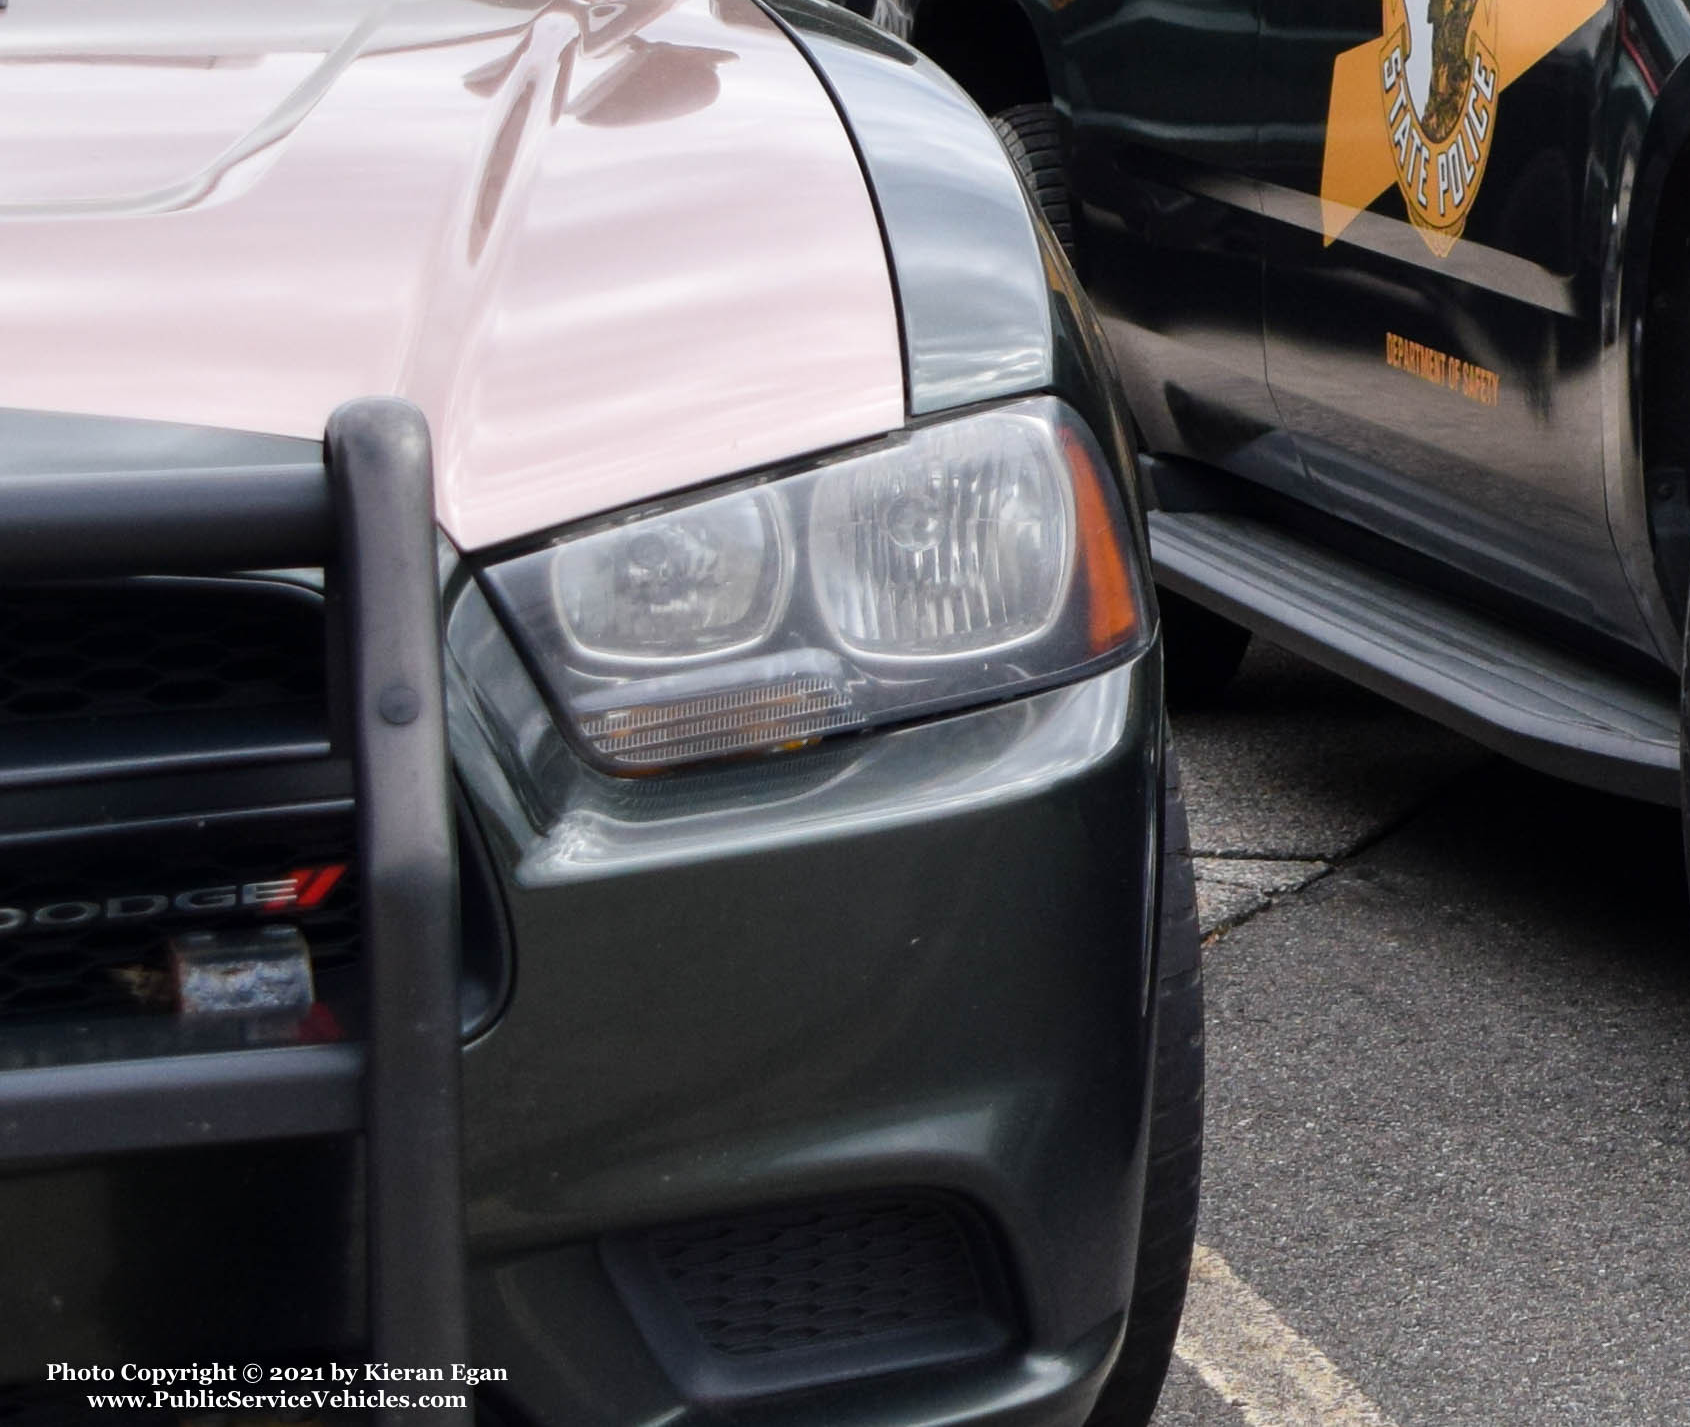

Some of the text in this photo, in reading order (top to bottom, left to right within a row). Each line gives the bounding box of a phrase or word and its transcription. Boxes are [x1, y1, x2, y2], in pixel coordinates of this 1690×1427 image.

[1383, 45, 1495, 217] STATE POLICE
[1385, 331, 1500, 407] DEPARTMENT OF SAFETY
